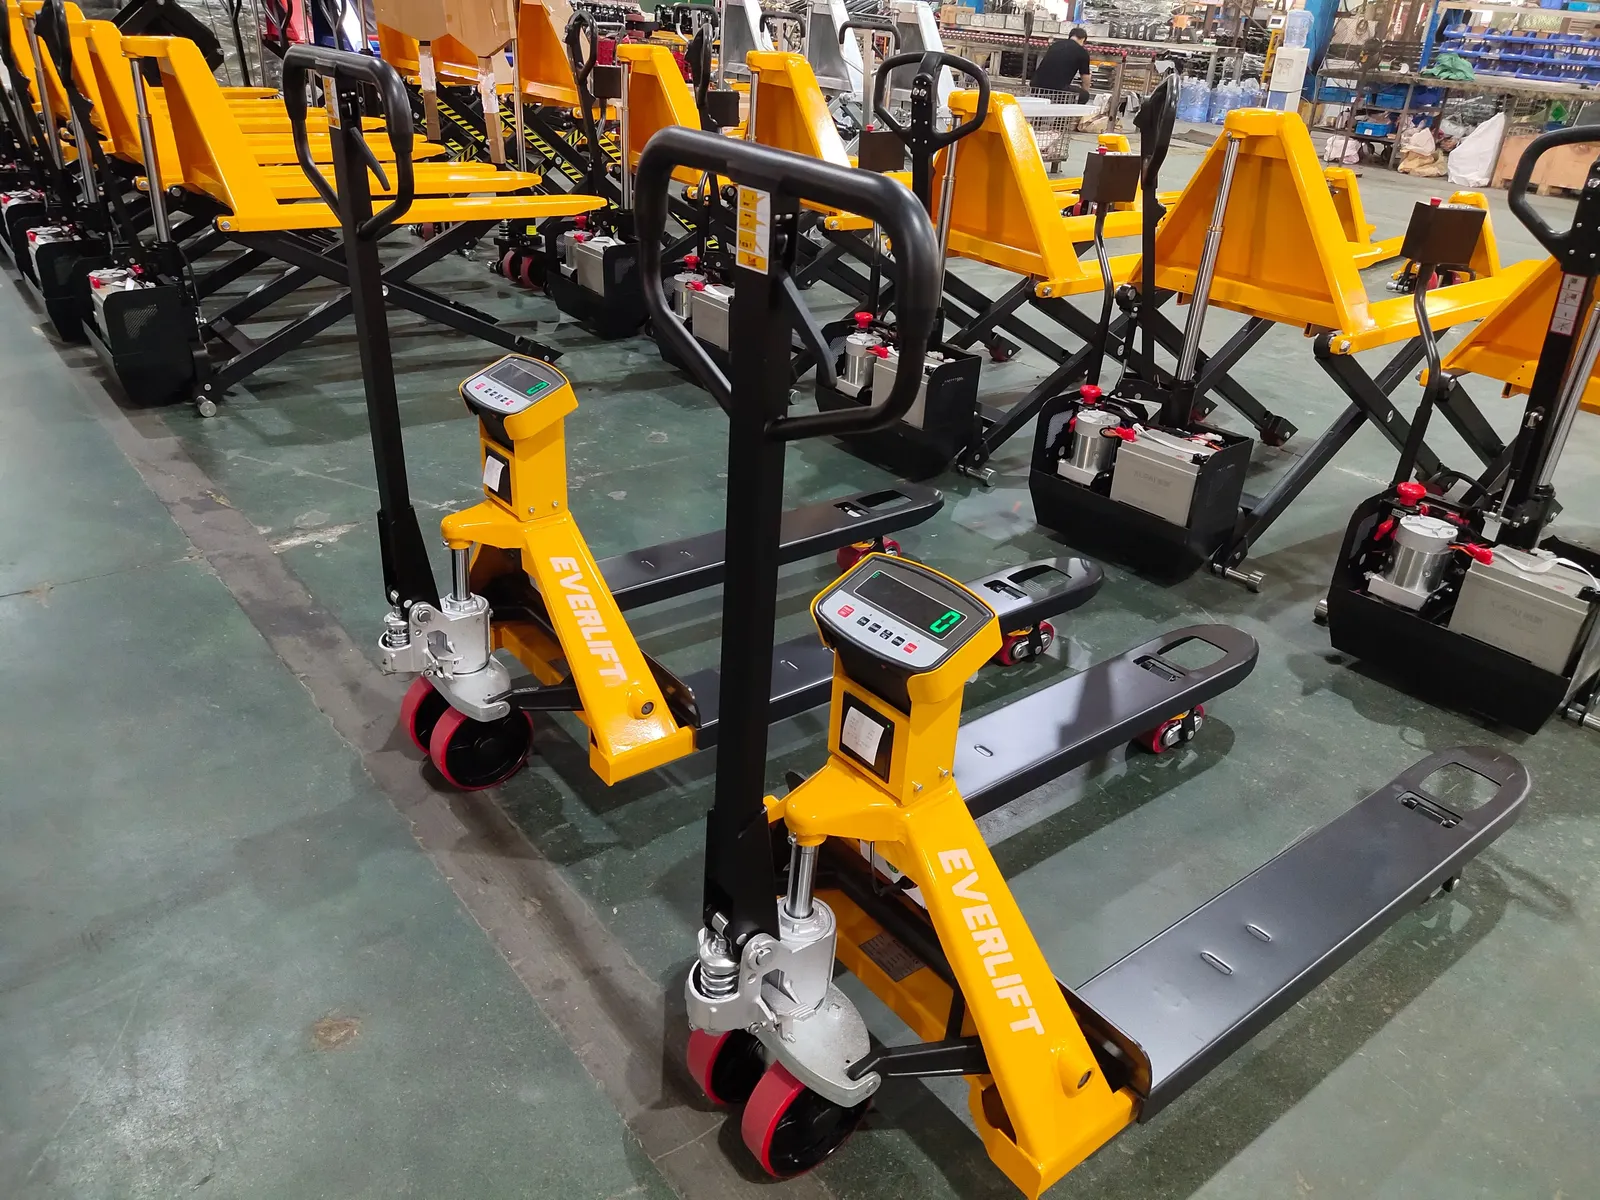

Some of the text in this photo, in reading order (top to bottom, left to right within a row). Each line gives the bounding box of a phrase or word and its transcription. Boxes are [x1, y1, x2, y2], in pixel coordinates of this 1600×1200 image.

[526, 380, 549, 396] 0
[549, 556, 628, 684] EVERLIFT
[928, 609, 962, 635] 0
[937, 848, 1045, 1036] EVERLIFT
